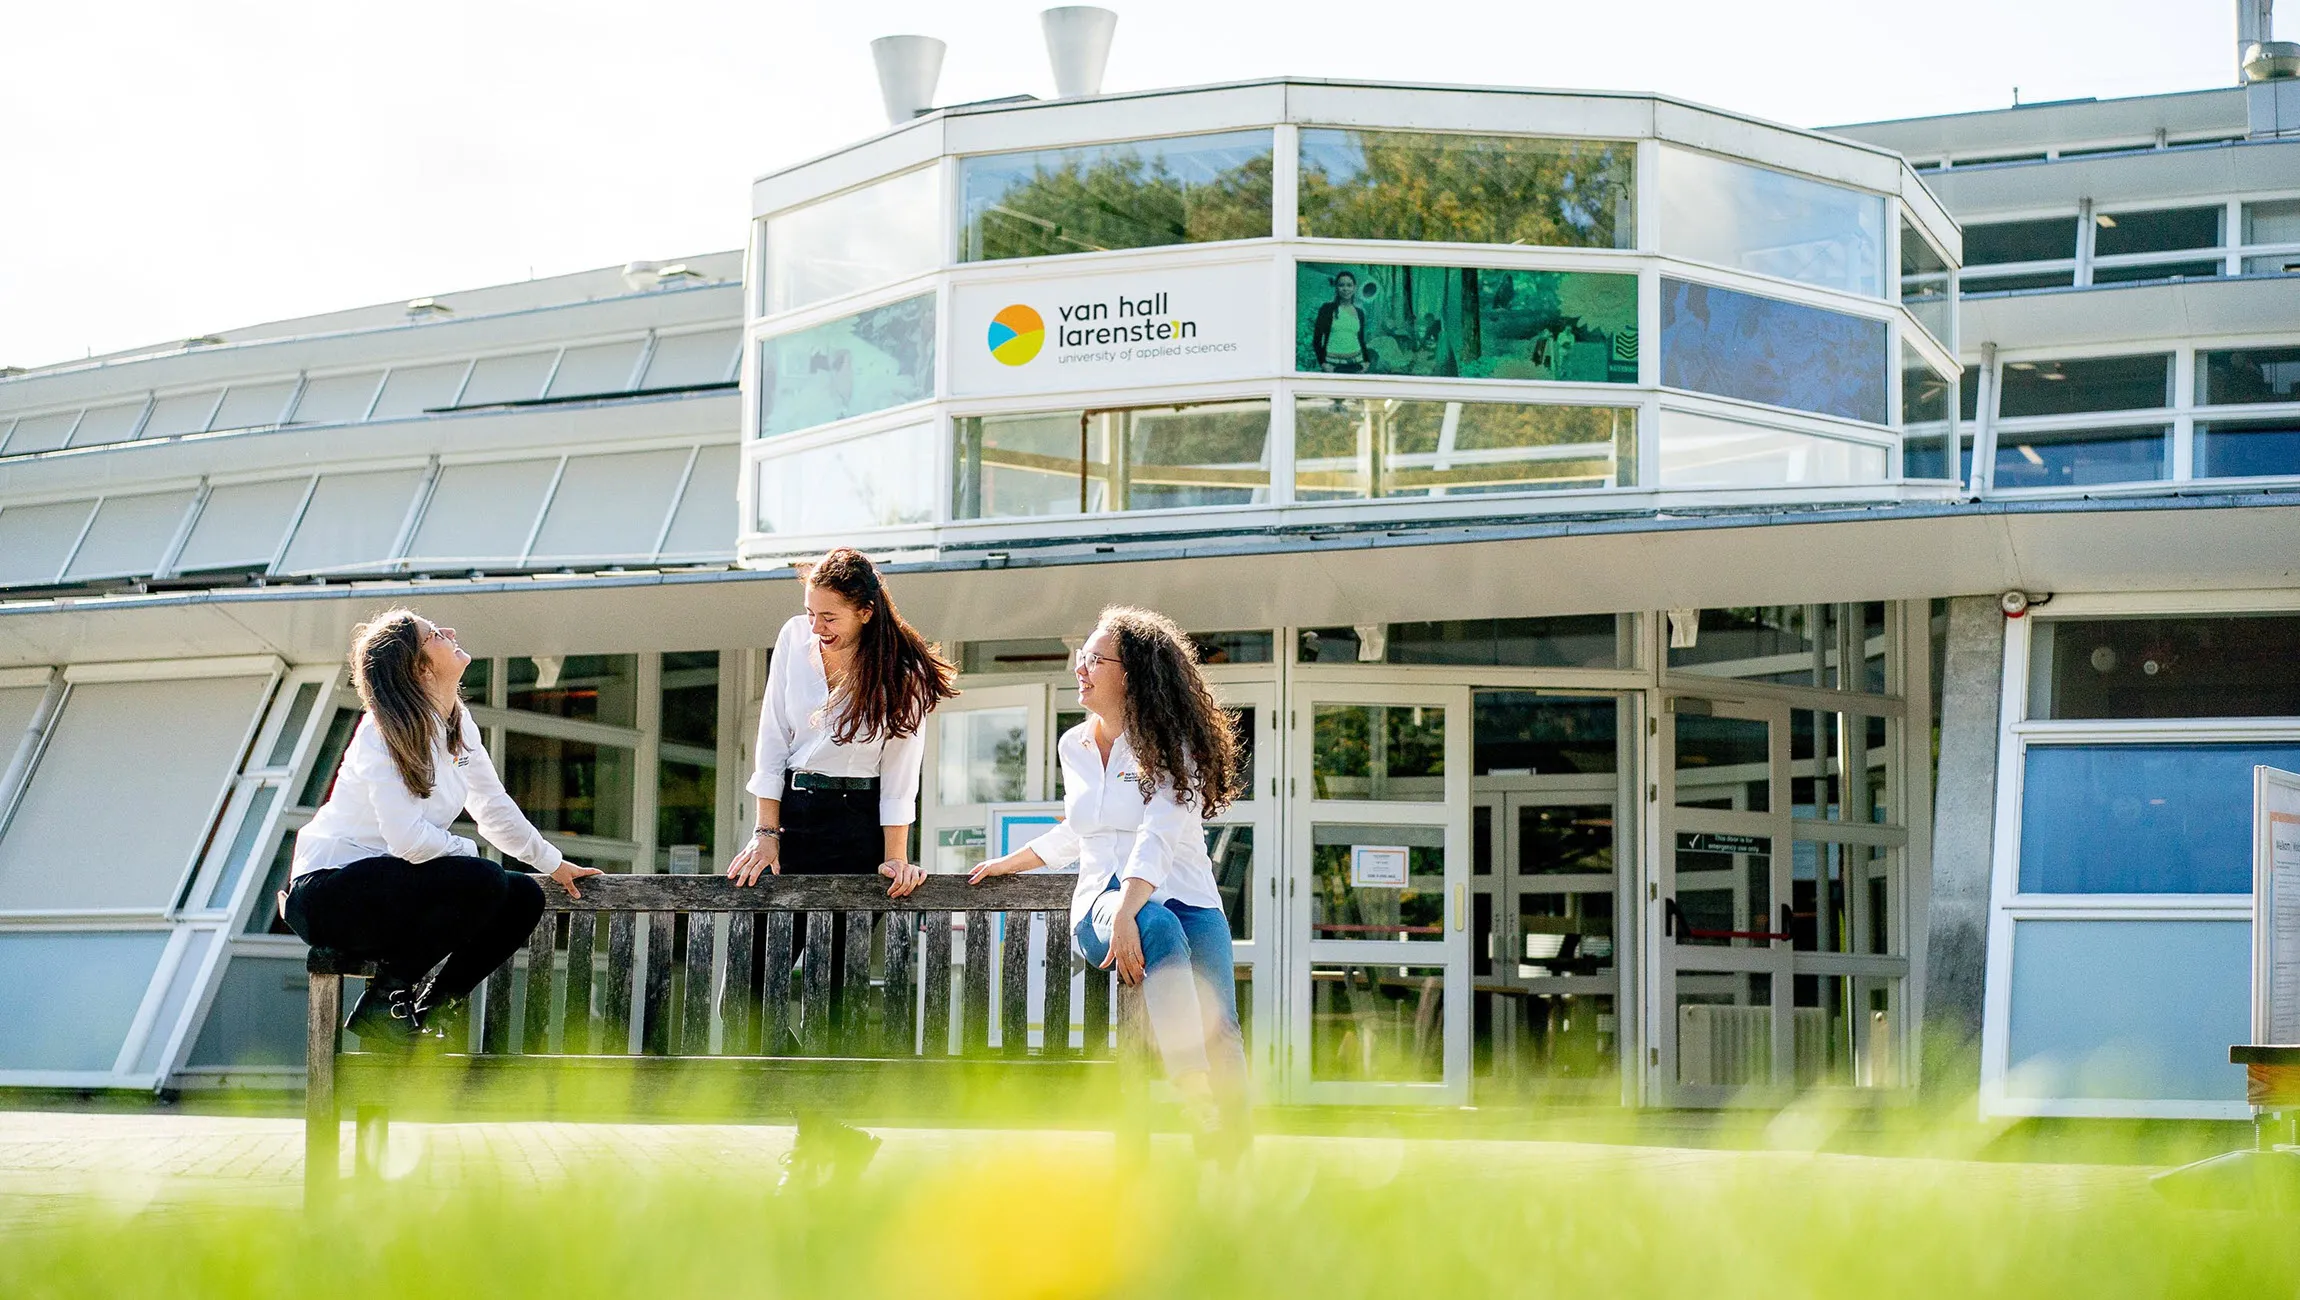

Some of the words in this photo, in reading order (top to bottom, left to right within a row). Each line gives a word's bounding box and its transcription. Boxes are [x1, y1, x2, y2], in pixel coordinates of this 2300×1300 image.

[1059, 303, 1107, 322] van
[1119, 292, 1168, 318] hall
[1058, 350, 1117, 364] university
[1119, 348, 1133, 361] of
[1136, 345, 1181, 359] applied
[1184, 342, 1238, 356] sciences
